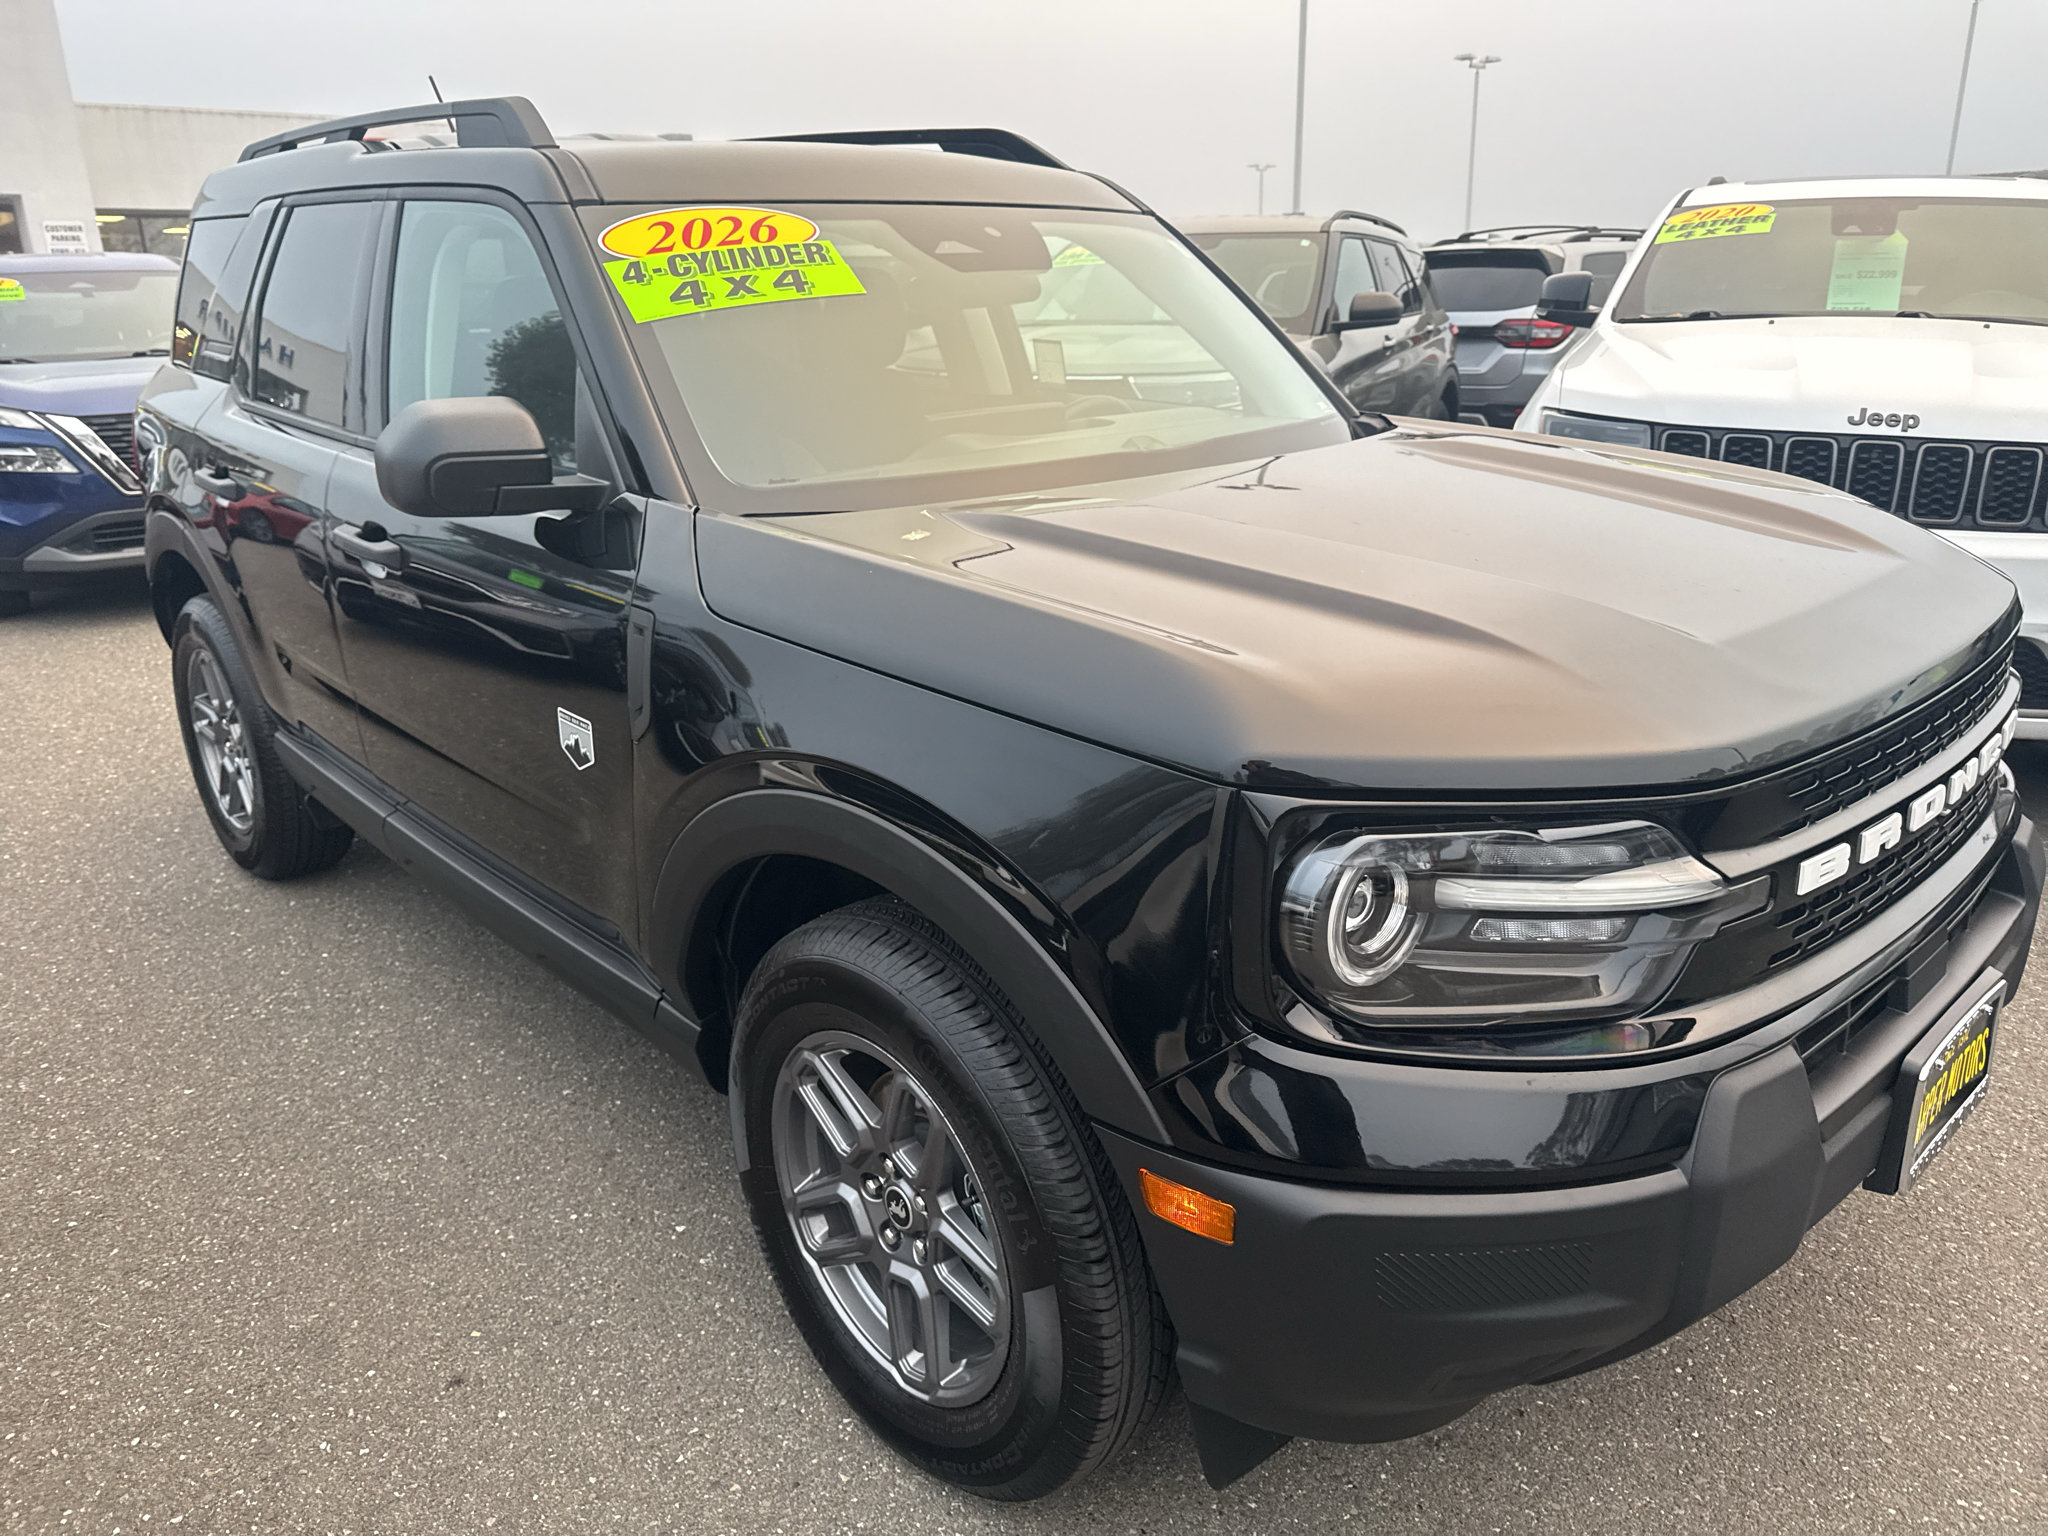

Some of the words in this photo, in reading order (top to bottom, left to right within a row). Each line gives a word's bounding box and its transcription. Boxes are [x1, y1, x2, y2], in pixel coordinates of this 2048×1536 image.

[1665, 214, 1772, 233] LEATHER
[1674, 230, 1695, 239] 4
[1724, 225, 1747, 233] 4
[1682, 206, 1756, 223] 2020
[646, 214, 779, 255] 2026
[622, 241, 835, 285] 4-CYLINDER
[669, 279, 711, 307] 4
[772, 269, 812, 294] 4
[1847, 407, 1920, 432] Jeep
[1796, 709, 2019, 896] BRONCO
[1944, 1027, 1989, 1105] MOTORS
